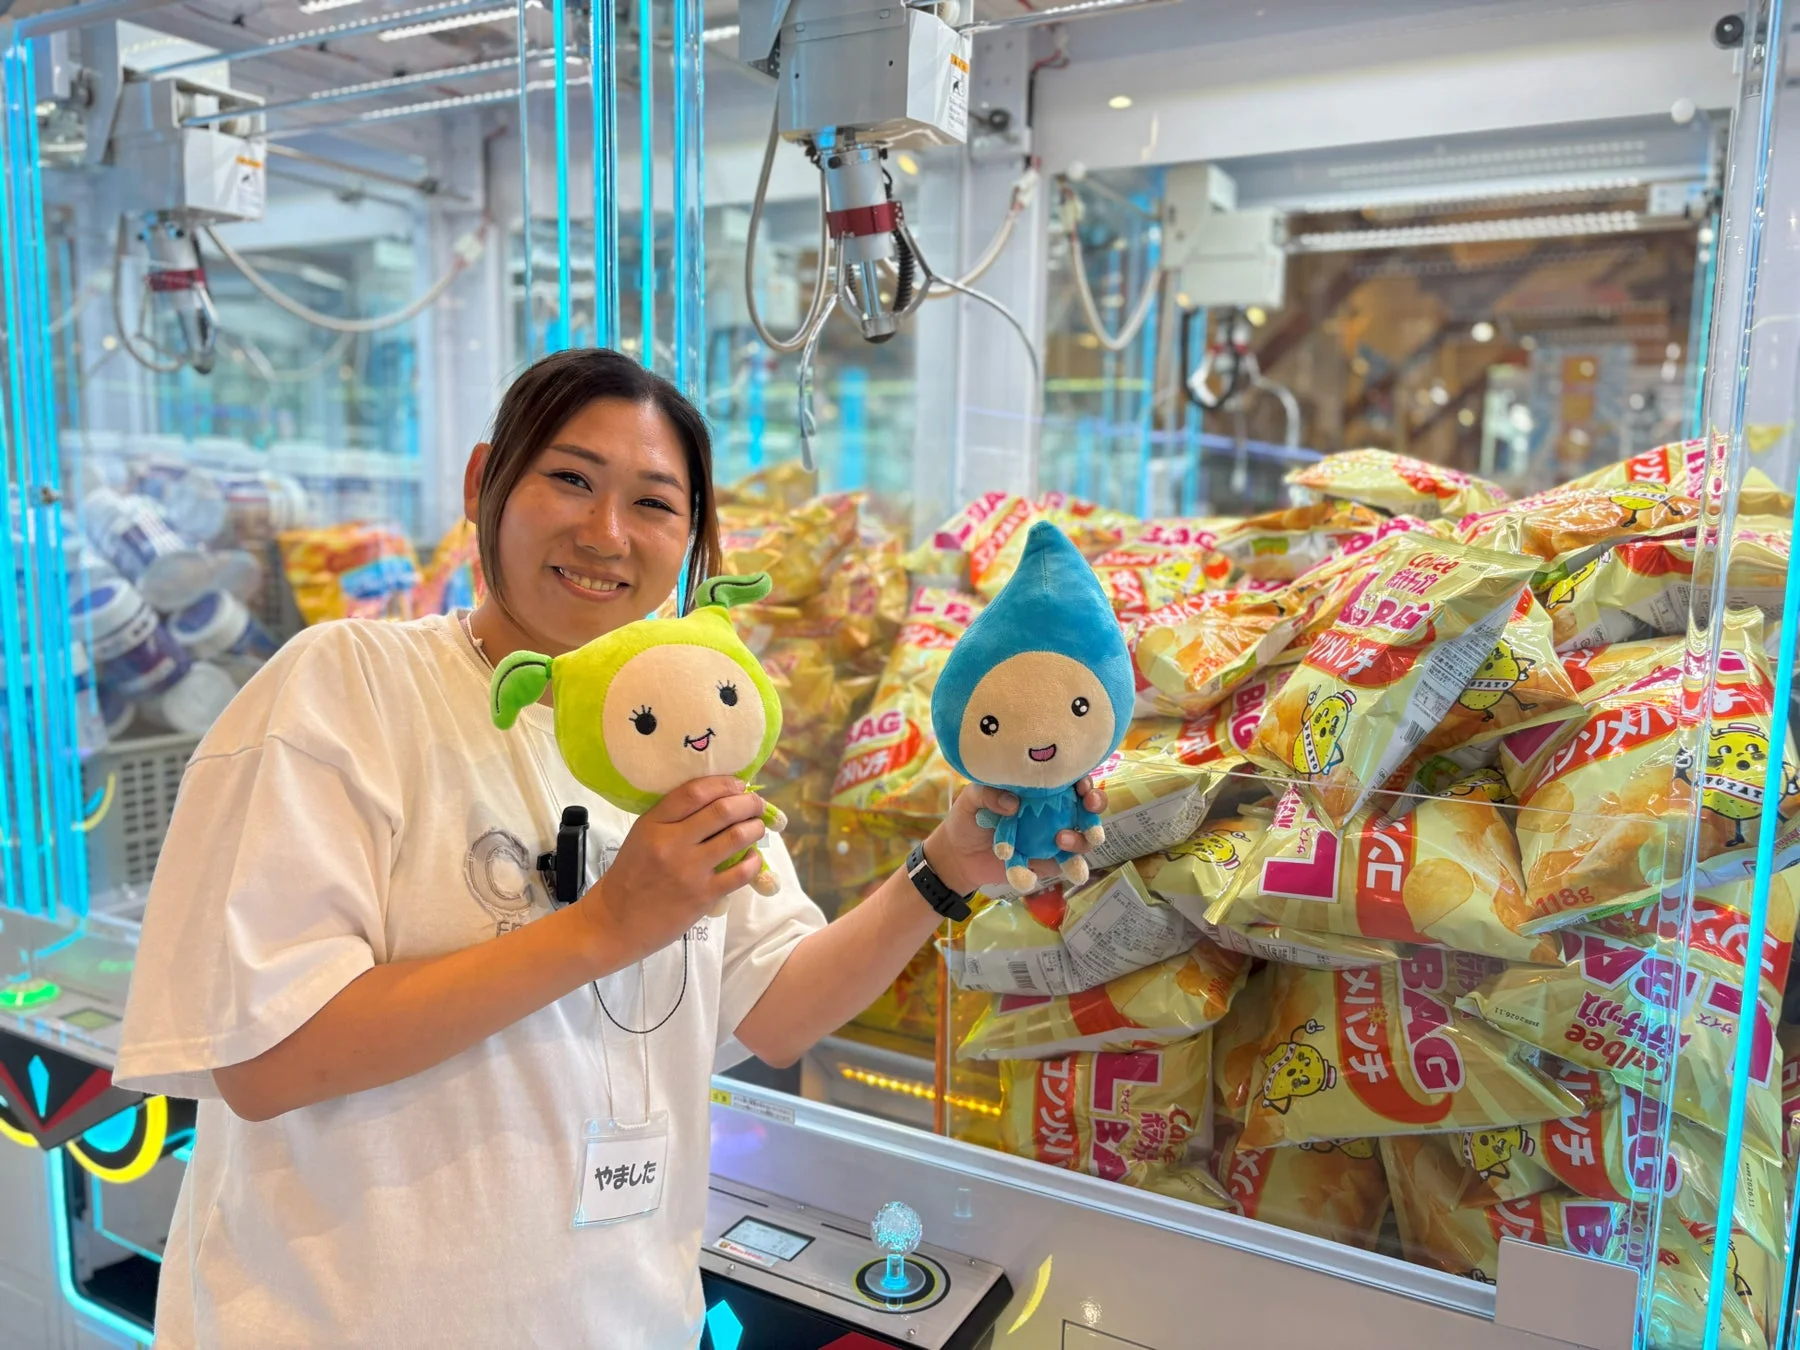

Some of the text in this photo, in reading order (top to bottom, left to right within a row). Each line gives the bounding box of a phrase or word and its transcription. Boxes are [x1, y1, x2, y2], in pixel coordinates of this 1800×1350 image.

[1407, 552, 1460, 576] Caee
[1304, 724, 1319, 771] POTATO
[1705, 777, 1763, 799] POTAT
[1296, 827, 1311, 855] サイズ
[1261, 829, 1340, 900] L
[1534, 886, 1596, 916] 118g
[1400, 949, 1464, 1092] BAG
[1093, 1052, 1160, 1113] L
[594, 1161, 657, 1191] やました
[1564, 1203, 1614, 1256] B
